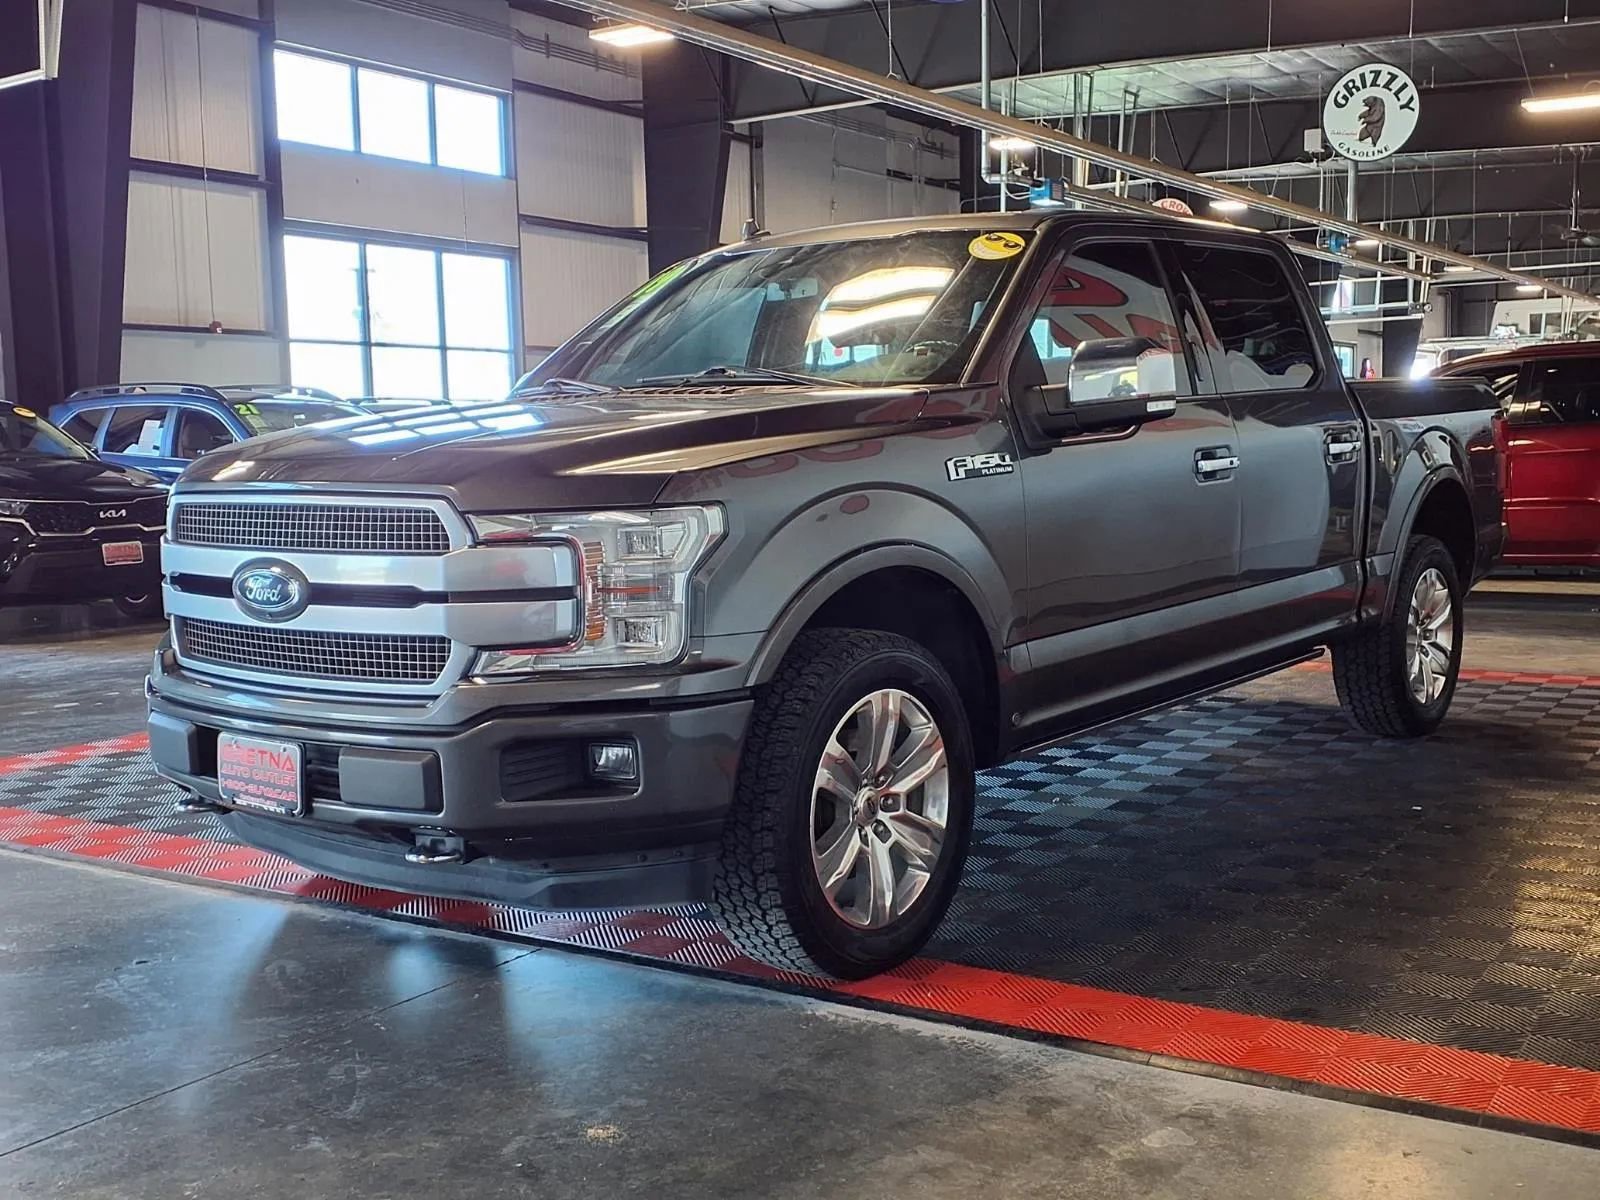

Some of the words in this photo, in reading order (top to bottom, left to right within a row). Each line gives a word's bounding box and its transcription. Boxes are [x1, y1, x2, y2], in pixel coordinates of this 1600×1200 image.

[1333, 69, 1415, 112] GRIZZLY
[1337, 142, 1391, 158] GASOLINE
[233, 403, 261, 416] 21
[981, 466, 1013, 475] PLATINUM
[244, 573, 283, 602] Ford
[221, 763, 250, 779] AUTO
[252, 768, 296, 787] OUTLET
